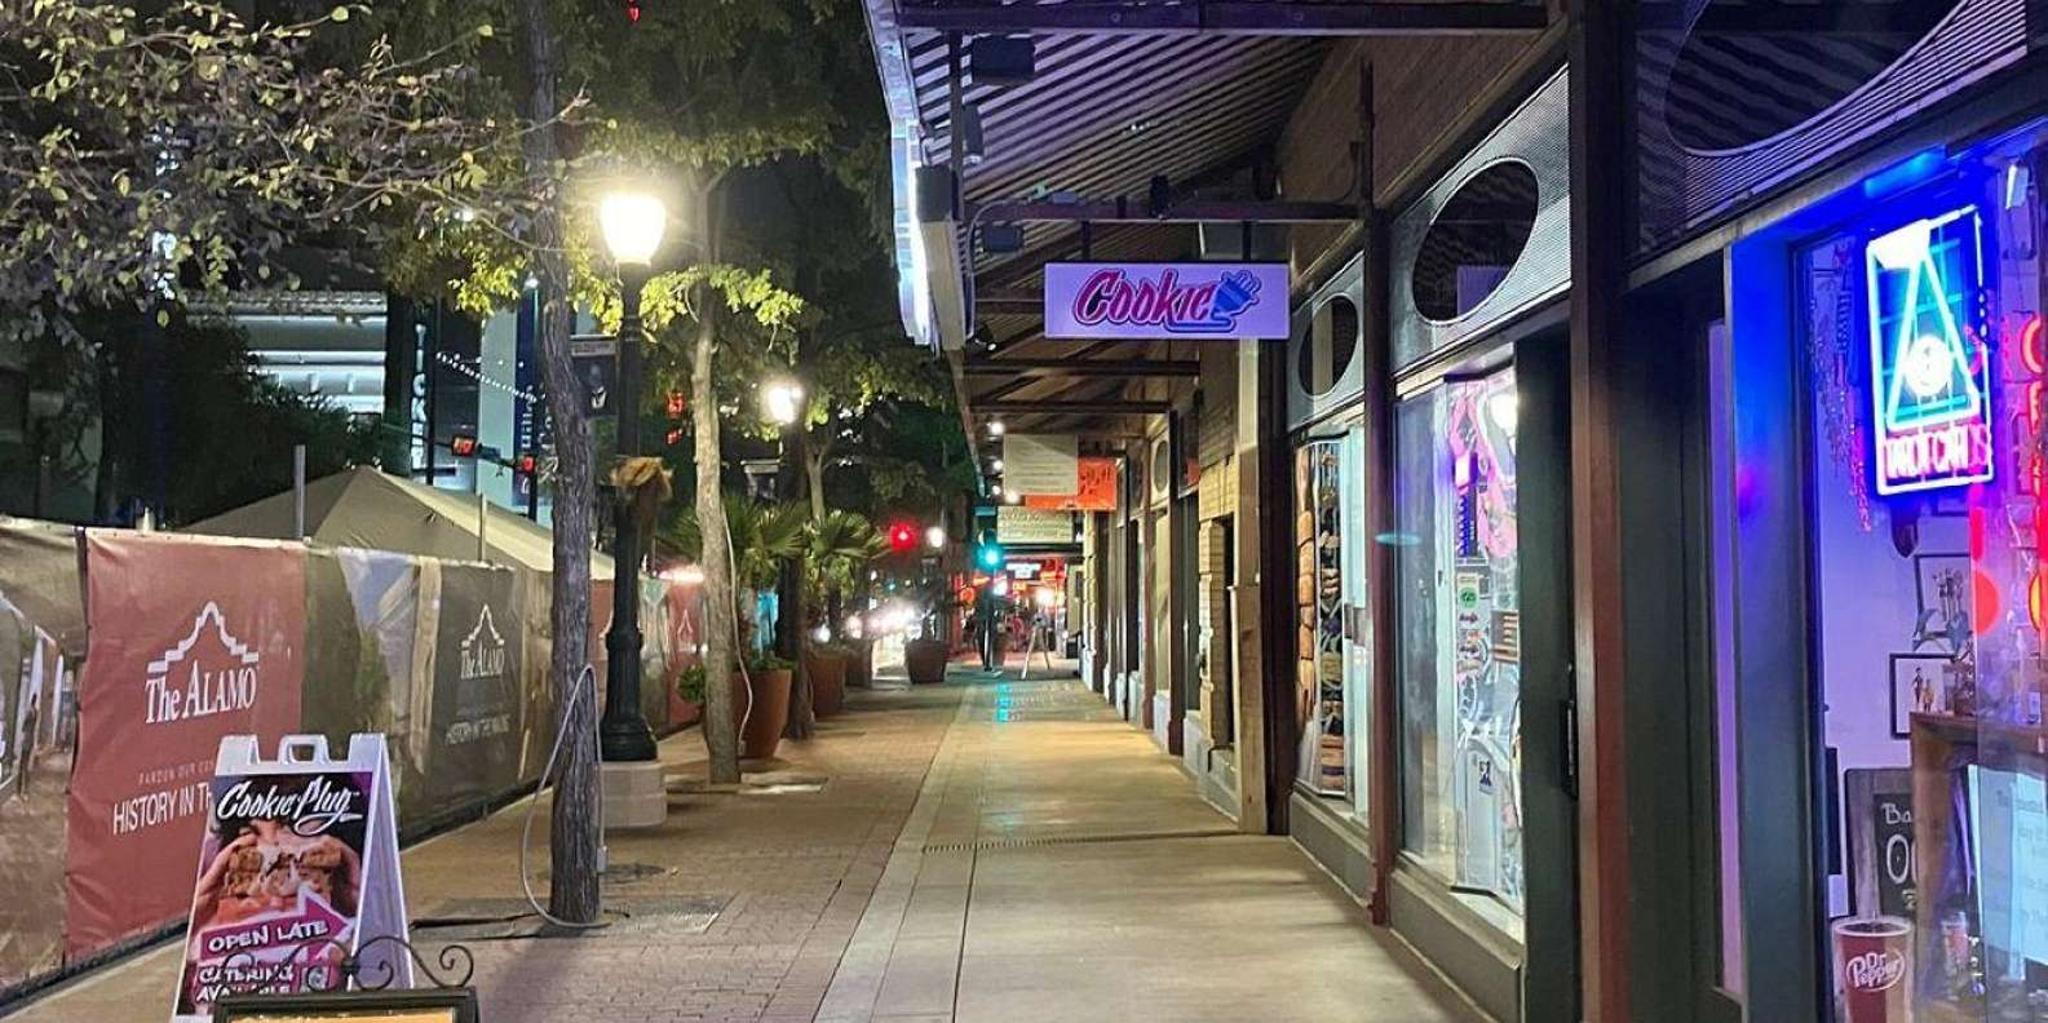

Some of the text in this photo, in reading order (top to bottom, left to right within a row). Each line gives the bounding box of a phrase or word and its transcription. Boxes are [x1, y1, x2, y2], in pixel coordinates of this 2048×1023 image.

[1073, 268, 1219, 328] Cookie
[145, 659, 258, 724] The ALAMO
[113, 781, 213, 835] HISTORY IN TH
[216, 775, 363, 837] Cookie Plug
[1881, 803, 1913, 824] Ba
[208, 920, 328, 953] OPEN LATE
[1852, 956, 1901, 988] Pepper
[1865, 952, 1888, 969] Dr
